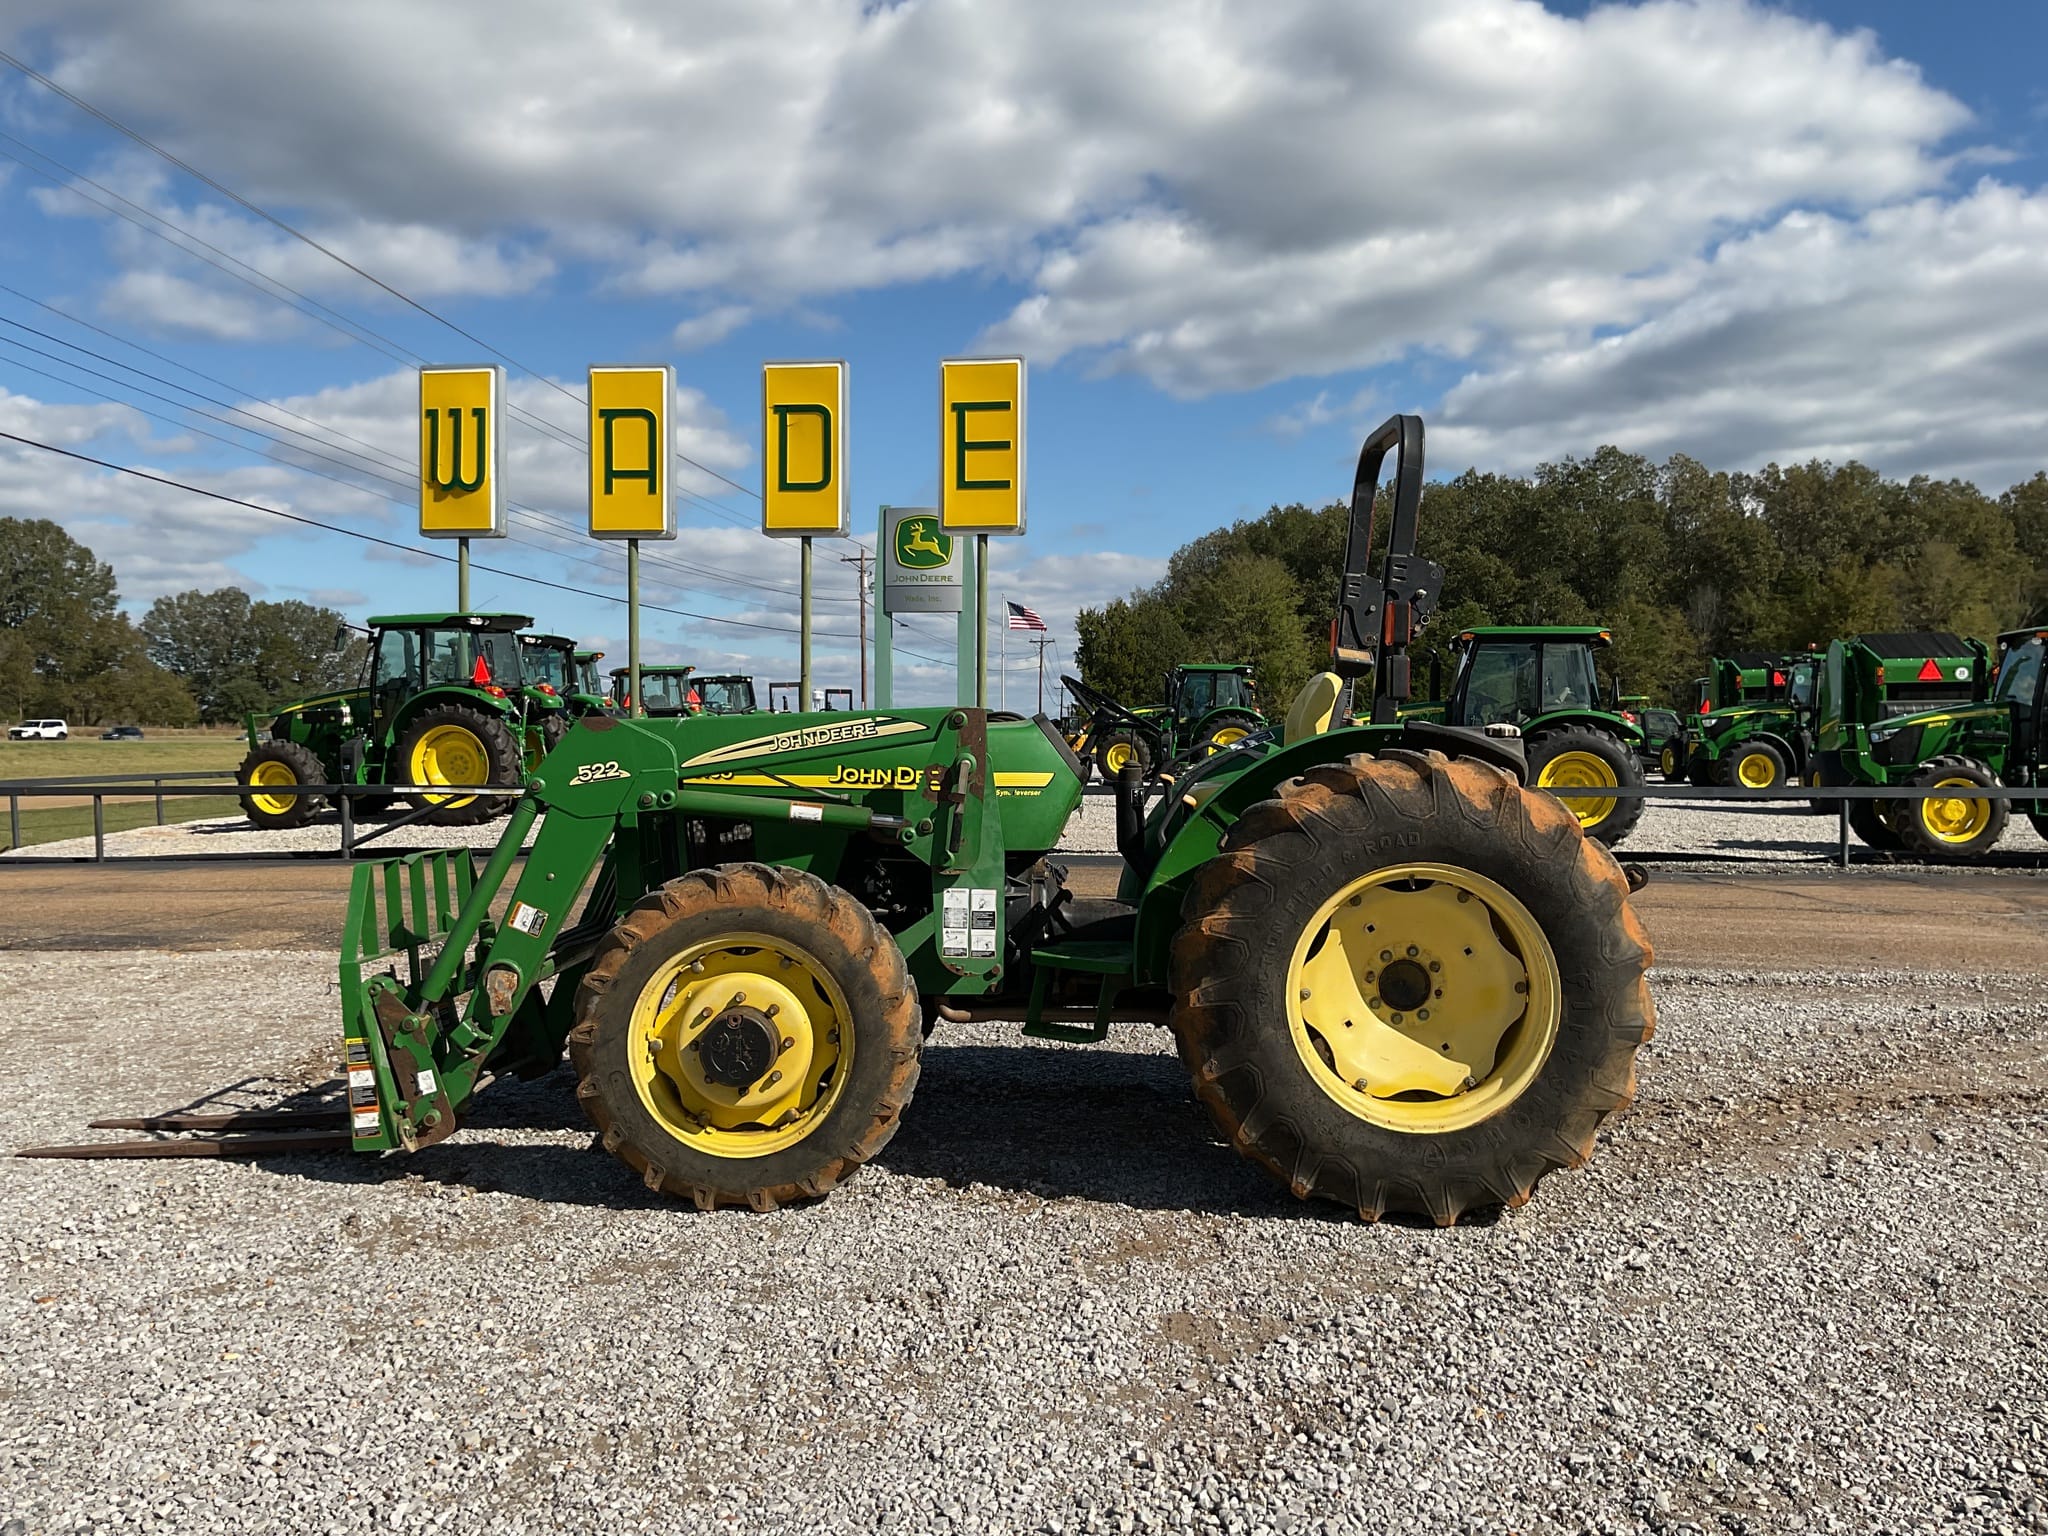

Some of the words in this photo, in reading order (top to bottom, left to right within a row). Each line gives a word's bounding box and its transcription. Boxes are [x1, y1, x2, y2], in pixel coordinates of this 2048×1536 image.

[769, 735, 816, 752] JOHN
[815, 722, 877, 745] DEERE
[577, 760, 620, 781] 522
[829, 764, 893, 785] JOHN
[1361, 830, 1421, 857] ROAD
